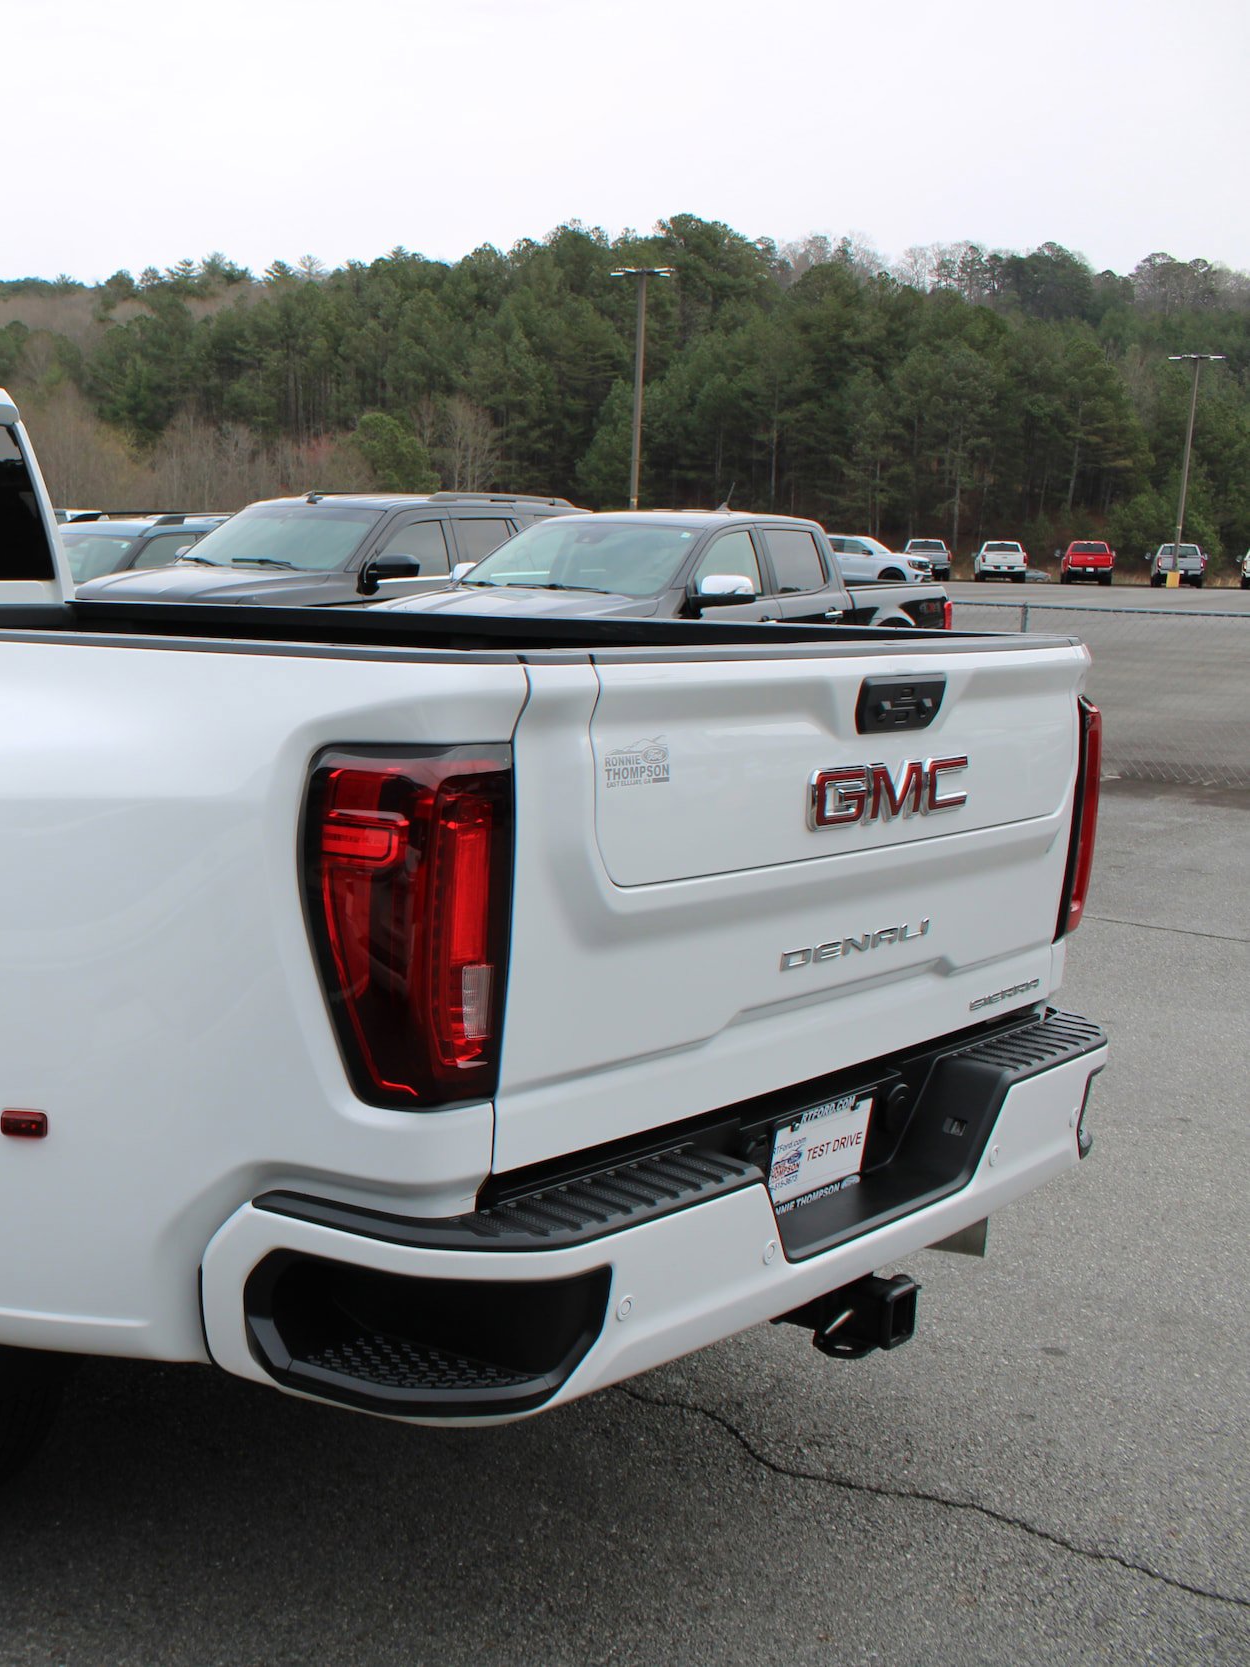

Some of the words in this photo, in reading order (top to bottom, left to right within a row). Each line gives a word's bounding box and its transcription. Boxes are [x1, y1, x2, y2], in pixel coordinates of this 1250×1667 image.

[605, 755, 641, 767] RONNIE
[605, 764, 669, 780] THOMPSON
[806, 754, 969, 833] GMC
[780, 917, 930, 972] DENALI
[969, 978, 1040, 1011] SIERRA
[801, 1095, 855, 1123] RTFORD.COM
[806, 1142, 832, 1162] TEST
[832, 1131, 863, 1152] DRIVE
[796, 1183, 841, 1207] THOMPSON
